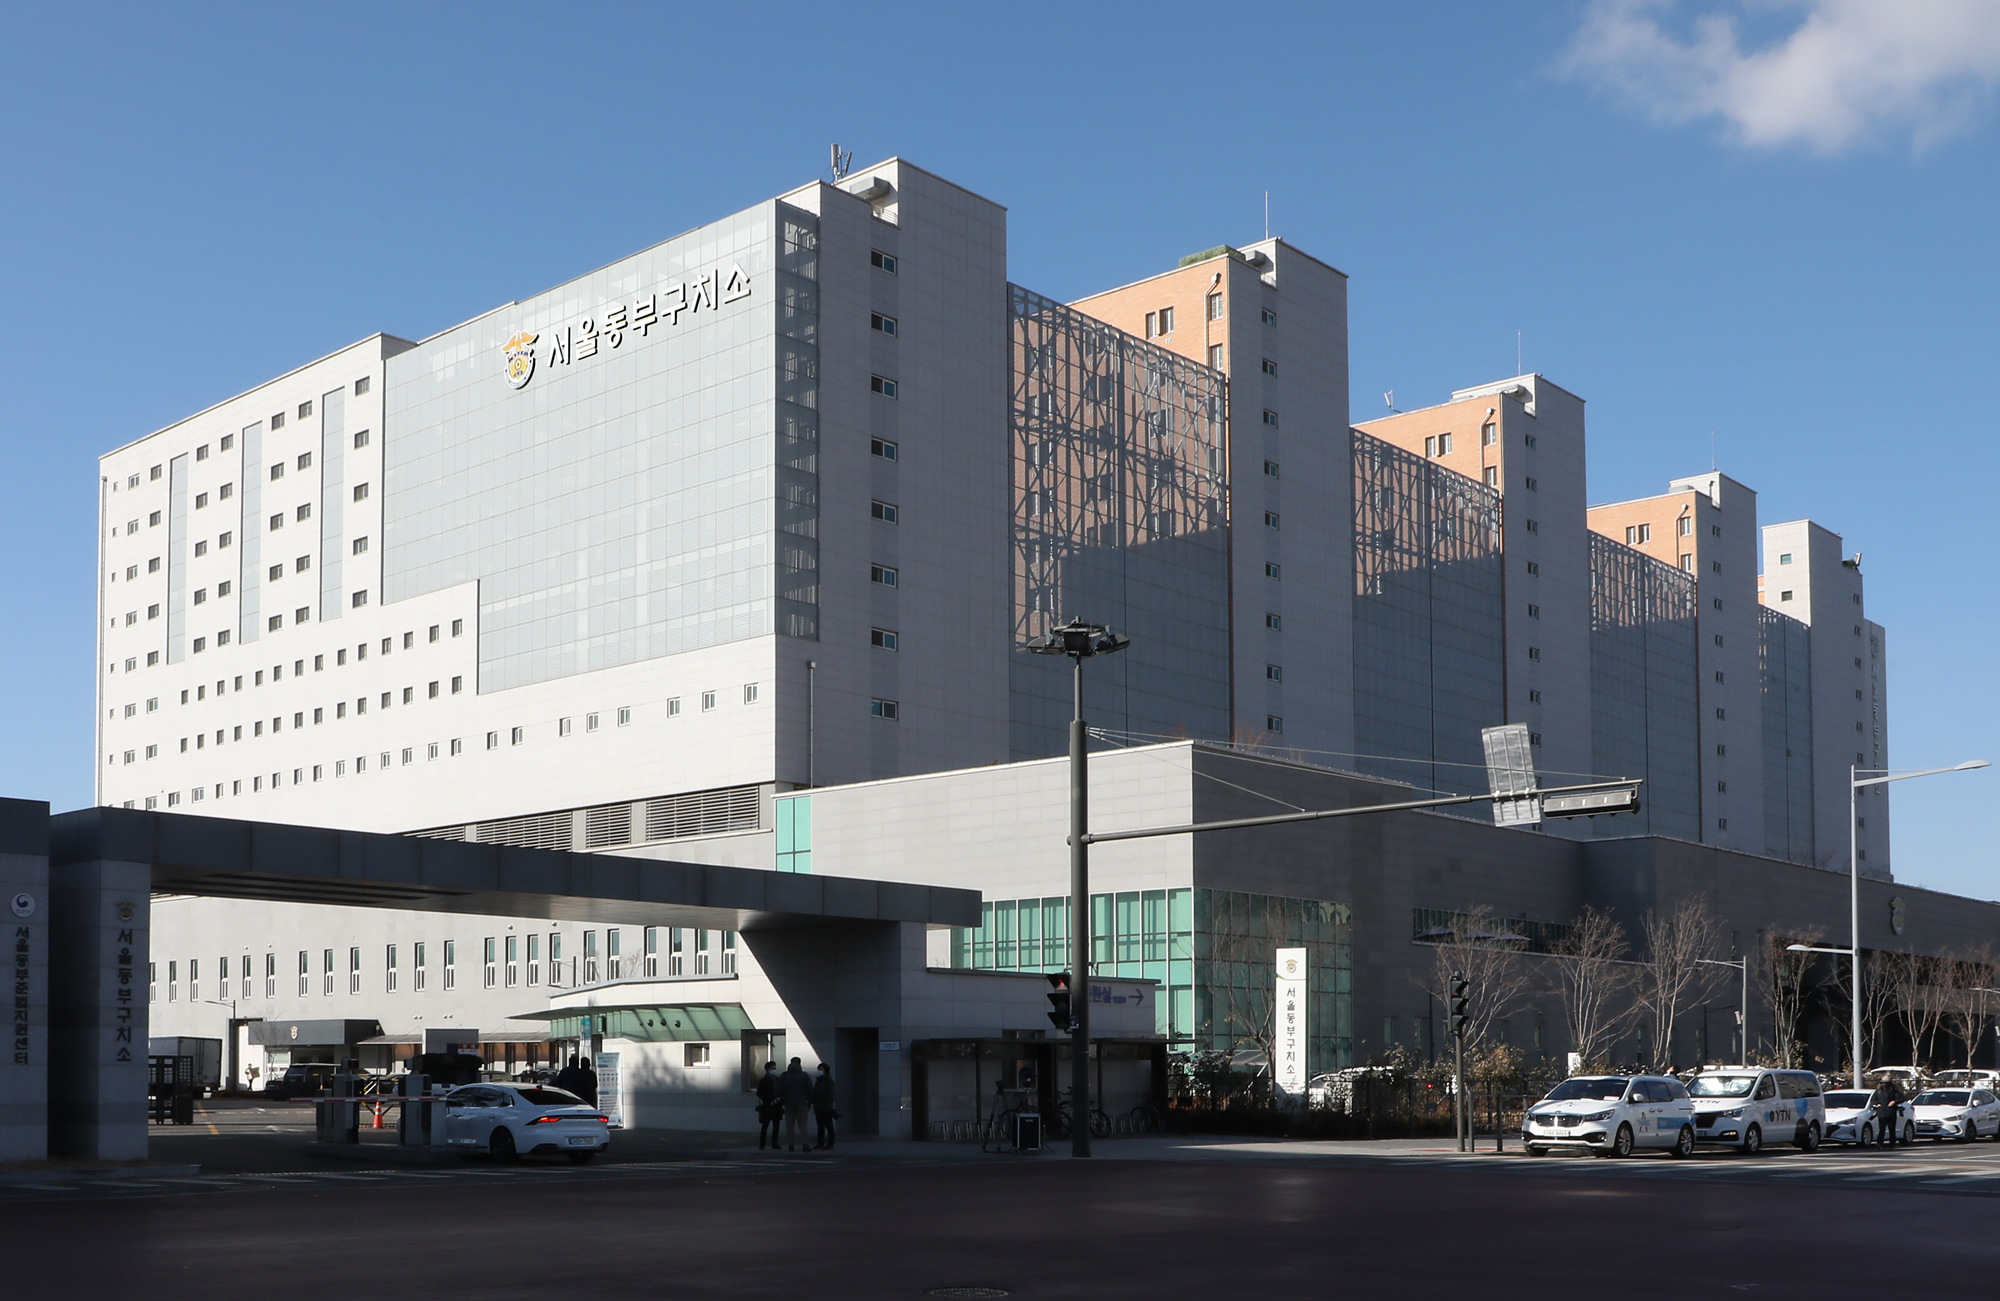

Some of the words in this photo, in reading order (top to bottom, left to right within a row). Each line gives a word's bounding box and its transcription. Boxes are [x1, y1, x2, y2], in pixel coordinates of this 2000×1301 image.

[547, 262, 751, 368] 서울동부구치소
[14, 926, 29, 1065] 서울동부준법지원센터
[116, 928, 133, 1062] 서울동부구치소
[1286, 987, 1296, 1074] 서울동부구치소
[1775, 1109, 1791, 1121] YTN
